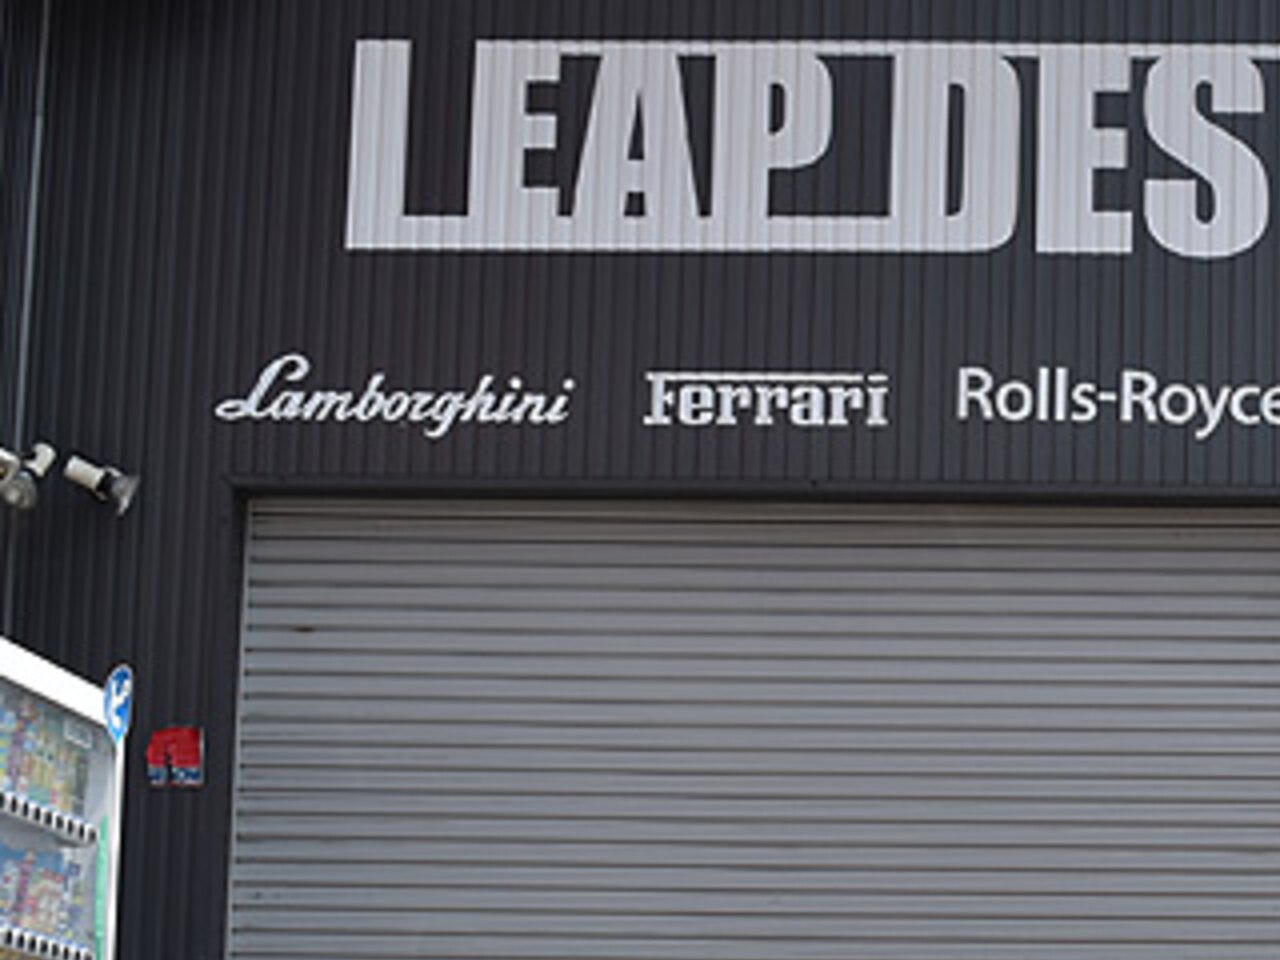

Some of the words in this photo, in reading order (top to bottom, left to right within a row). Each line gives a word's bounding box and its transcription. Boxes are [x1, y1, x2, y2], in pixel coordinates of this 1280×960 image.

[346, 40, 834, 251] LEAP
[215, 354, 575, 438] Lamborghini
[643, 371, 889, 426] Ferrari
